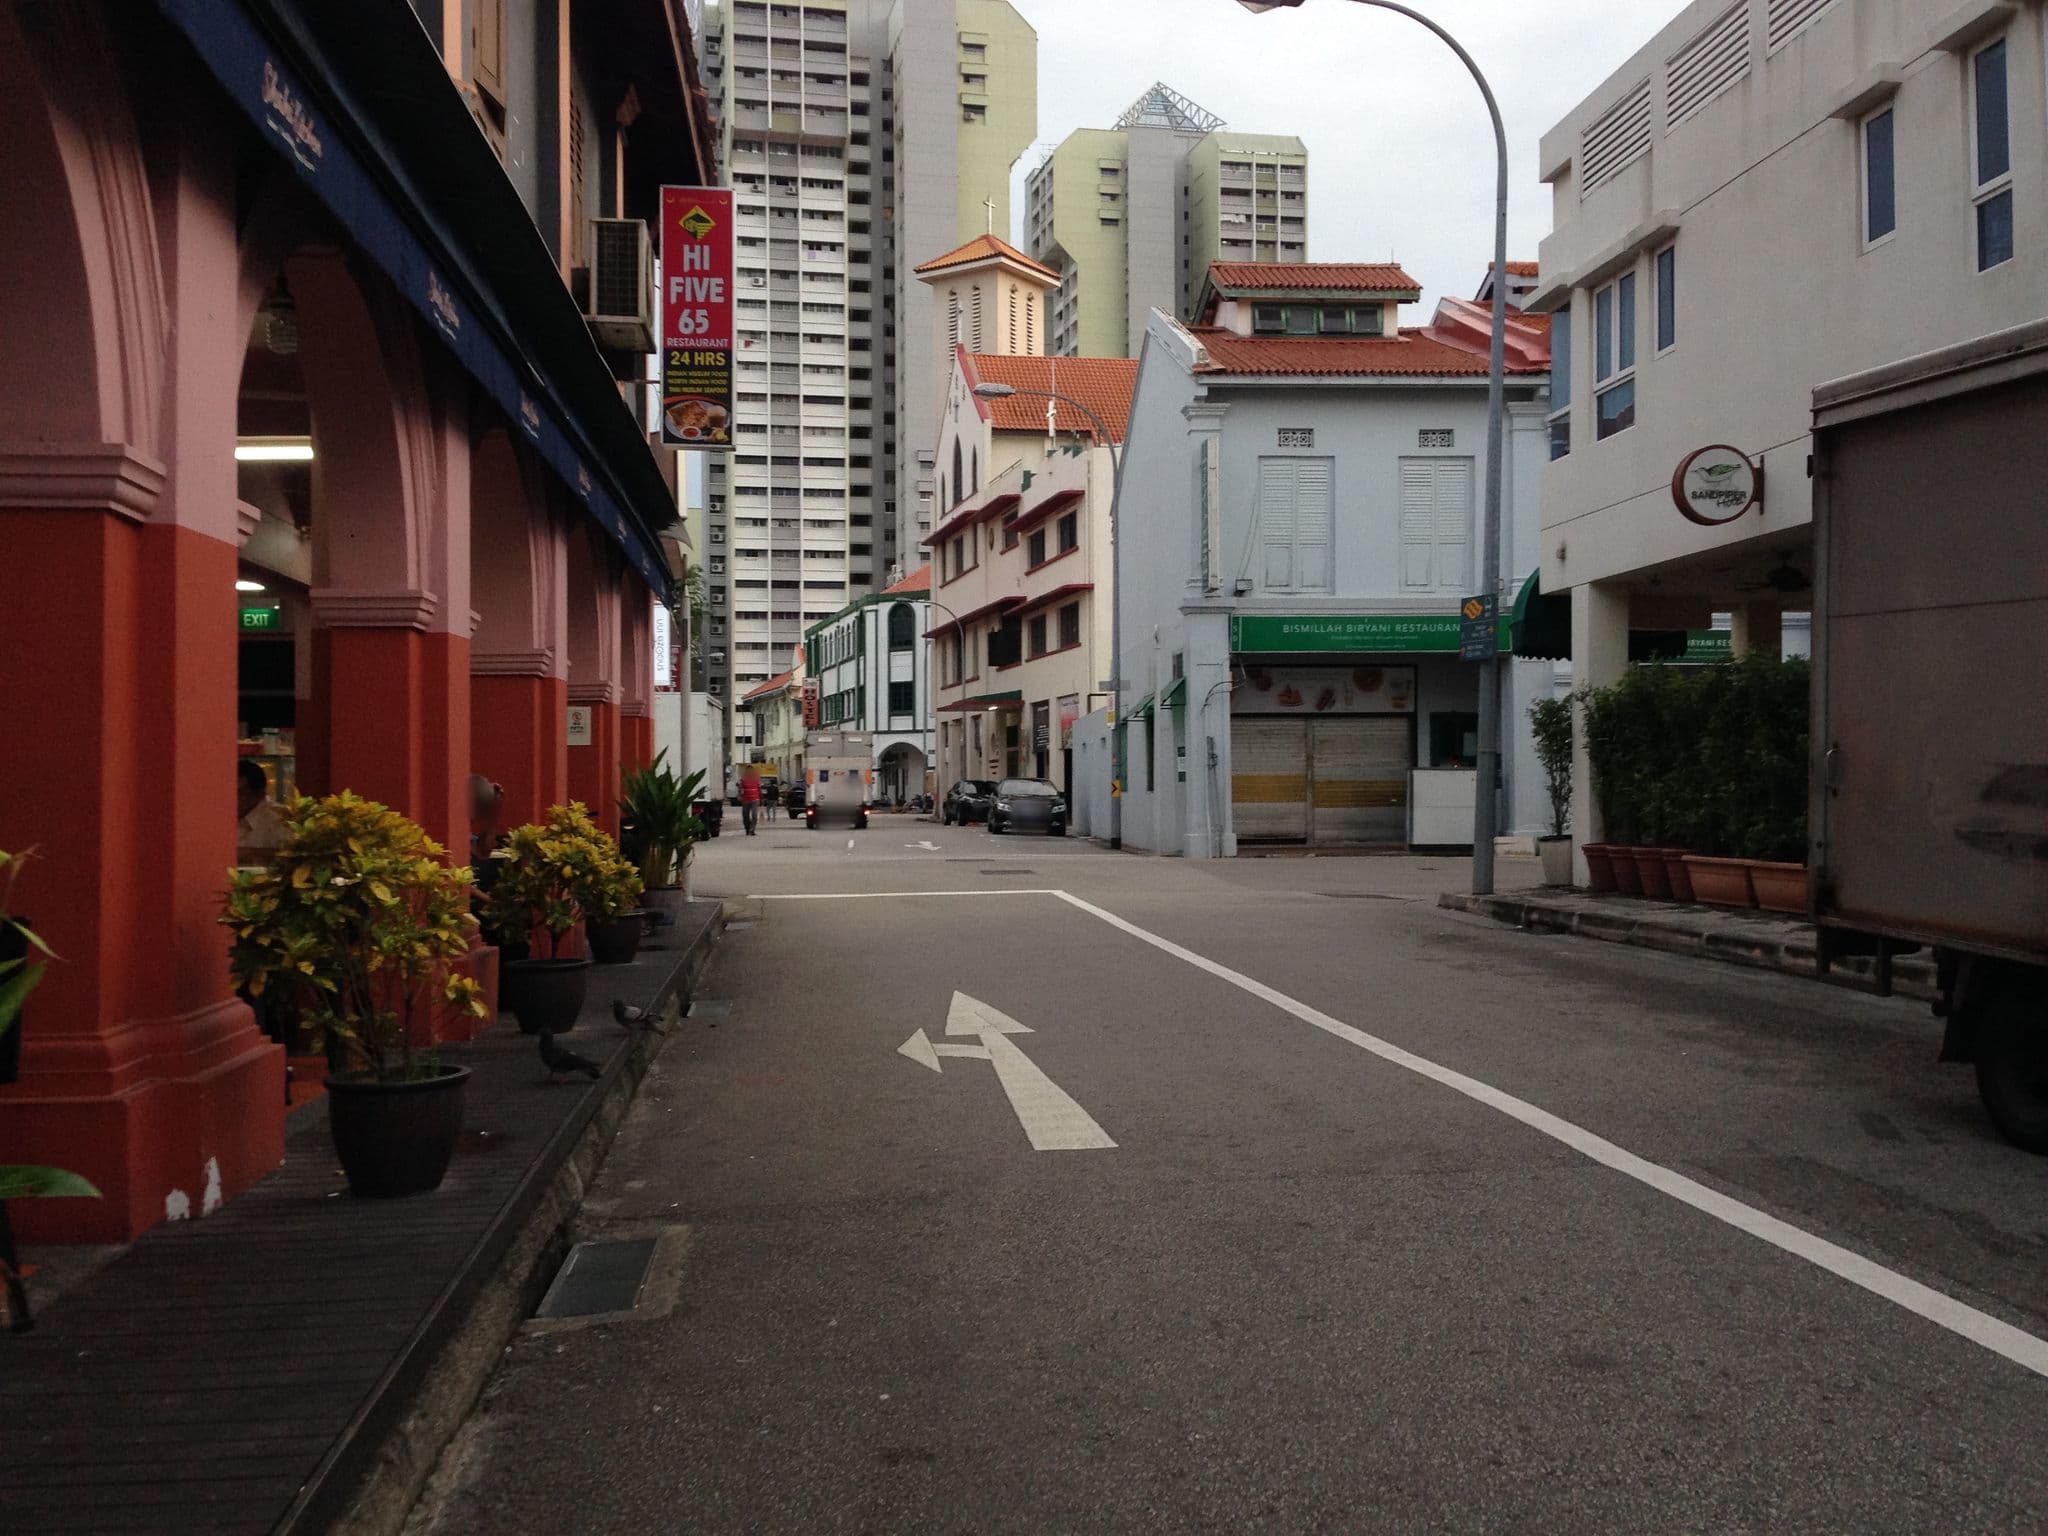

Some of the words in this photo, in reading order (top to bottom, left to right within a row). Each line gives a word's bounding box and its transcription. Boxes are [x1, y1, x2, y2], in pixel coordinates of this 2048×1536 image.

[683, 244, 710, 273] HI
[670, 276, 725, 304] FIVE
[678, 308, 709, 335] 65
[667, 337, 729, 348] RESTAURANT
[671, 351, 690, 365] 24
[694, 352, 726, 366] HRS
[1691, 490, 1747, 500] SANDPIPER
[243, 614, 269, 626] EXIT
[1282, 624, 1342, 633] BISMILLAH
[1346, 624, 1391, 633] BIRYANI
[1395, 624, 1461, 632] RESTAURAN
[1687, 639, 1715, 647] IRYANI
[804, 688, 816, 726] HOSTEL
